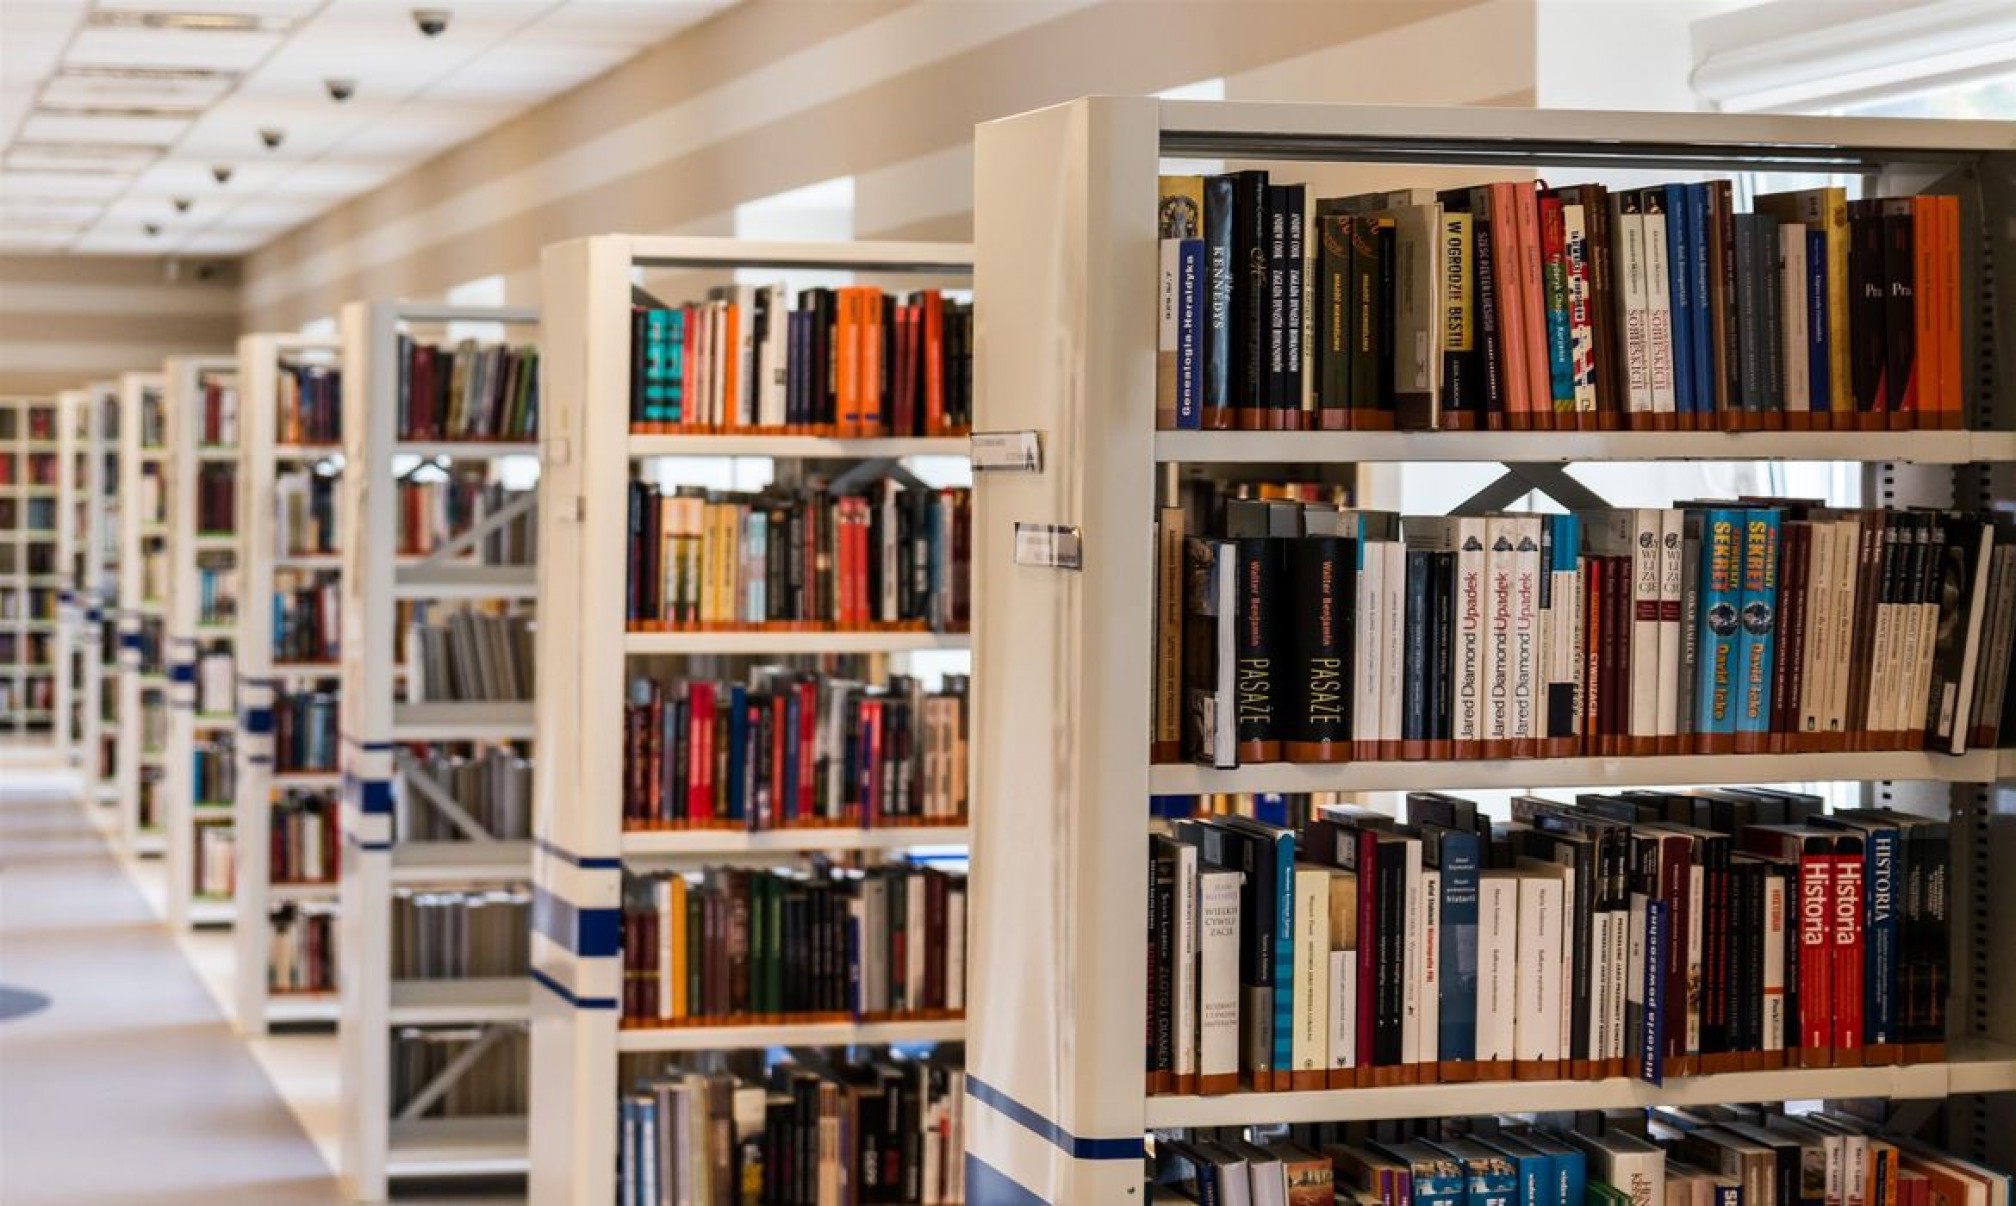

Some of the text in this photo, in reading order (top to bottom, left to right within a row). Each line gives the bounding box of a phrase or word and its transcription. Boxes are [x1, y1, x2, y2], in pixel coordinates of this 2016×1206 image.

[1212, 246, 1224, 330] KENNEDYS
[1448, 221, 1463, 347] W OGRODZIE BESTII
[1628, 309, 1642, 390] SOBIESKICH
[1711, 521, 1731, 591] SEKRET
[1247, 560, 1261, 648] Walter Benjamin
[1319, 560, 1334, 648] Walter Benjamin
[1745, 521, 1766, 718] SEKRET David Icke
[1239, 657, 1274, 725] PASAŻE
[1309, 657, 1345, 725] PASAŻE
[1461, 571, 1480, 739] Jared Diamond Upadek
[1492, 571, 1510, 739] Jared Diamond Upadek
[1515, 571, 1534, 738] Jared Diamond Upadek
[1715, 643, 1730, 683] David
[1805, 862, 1831, 945] Historia
[1836, 862, 1862, 945] Historia
[1874, 838, 1891, 922] HISTORIA
[1644, 902, 1659, 1080] Historia powszechna
